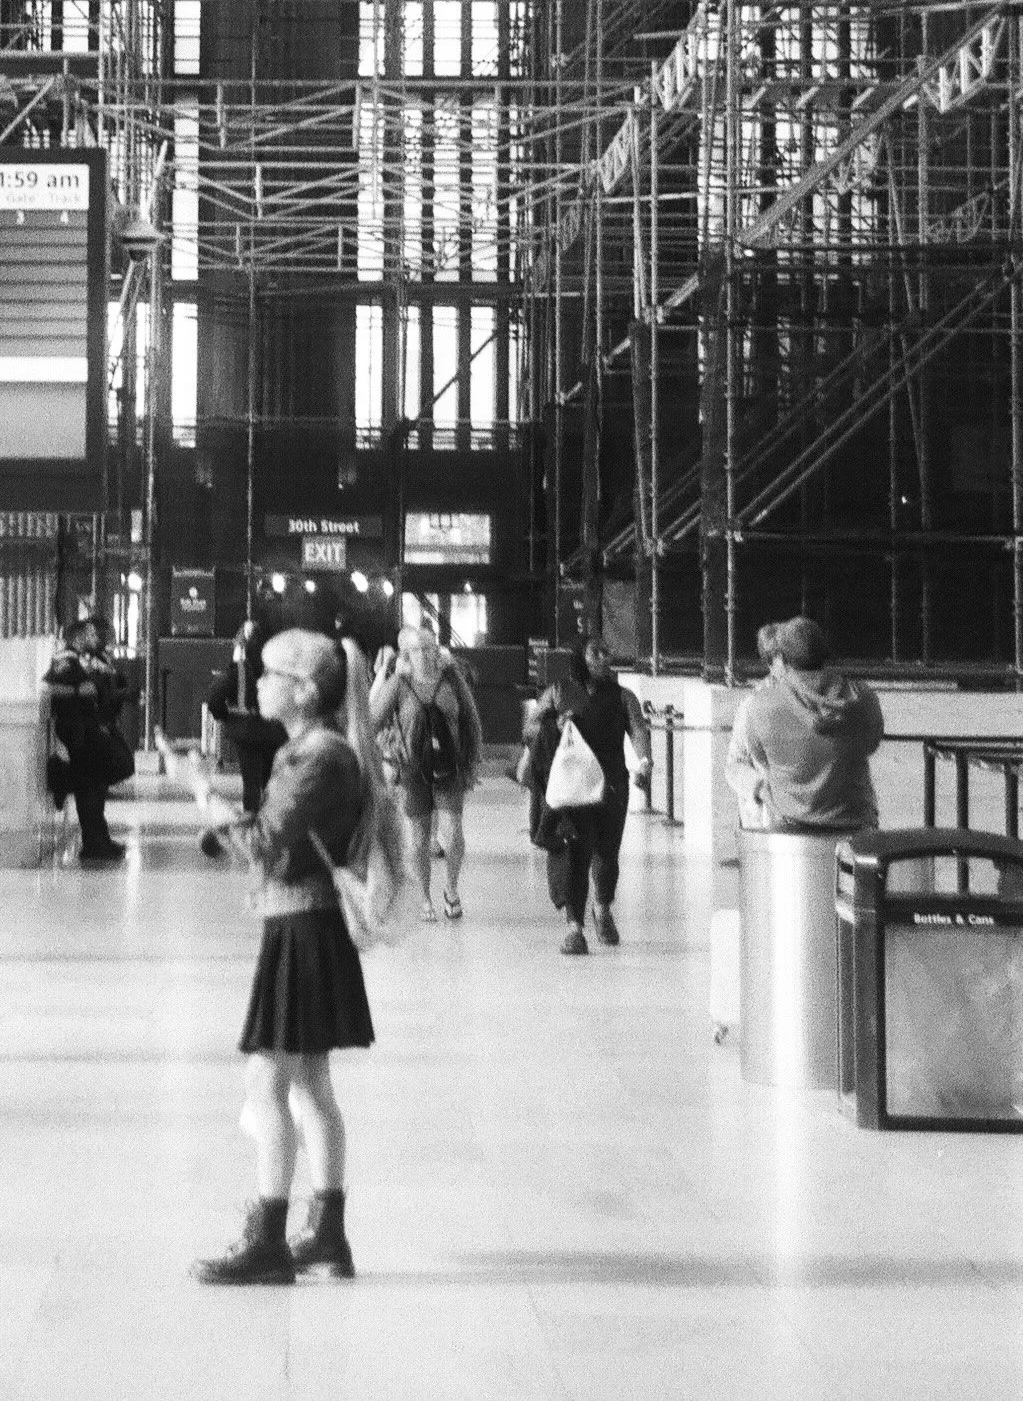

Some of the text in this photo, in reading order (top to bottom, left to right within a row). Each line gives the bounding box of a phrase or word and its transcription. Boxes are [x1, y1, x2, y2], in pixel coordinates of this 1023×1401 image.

[47, 174, 80, 189] am
[6, 193, 36, 203] Gate
[50, 193, 81, 203] Track
[61, 212, 68, 224] 4
[288, 519, 360, 533] 30th Street
[304, 543, 343, 563] EXIT
[914, 912, 995, 925] Bottles & Cans
